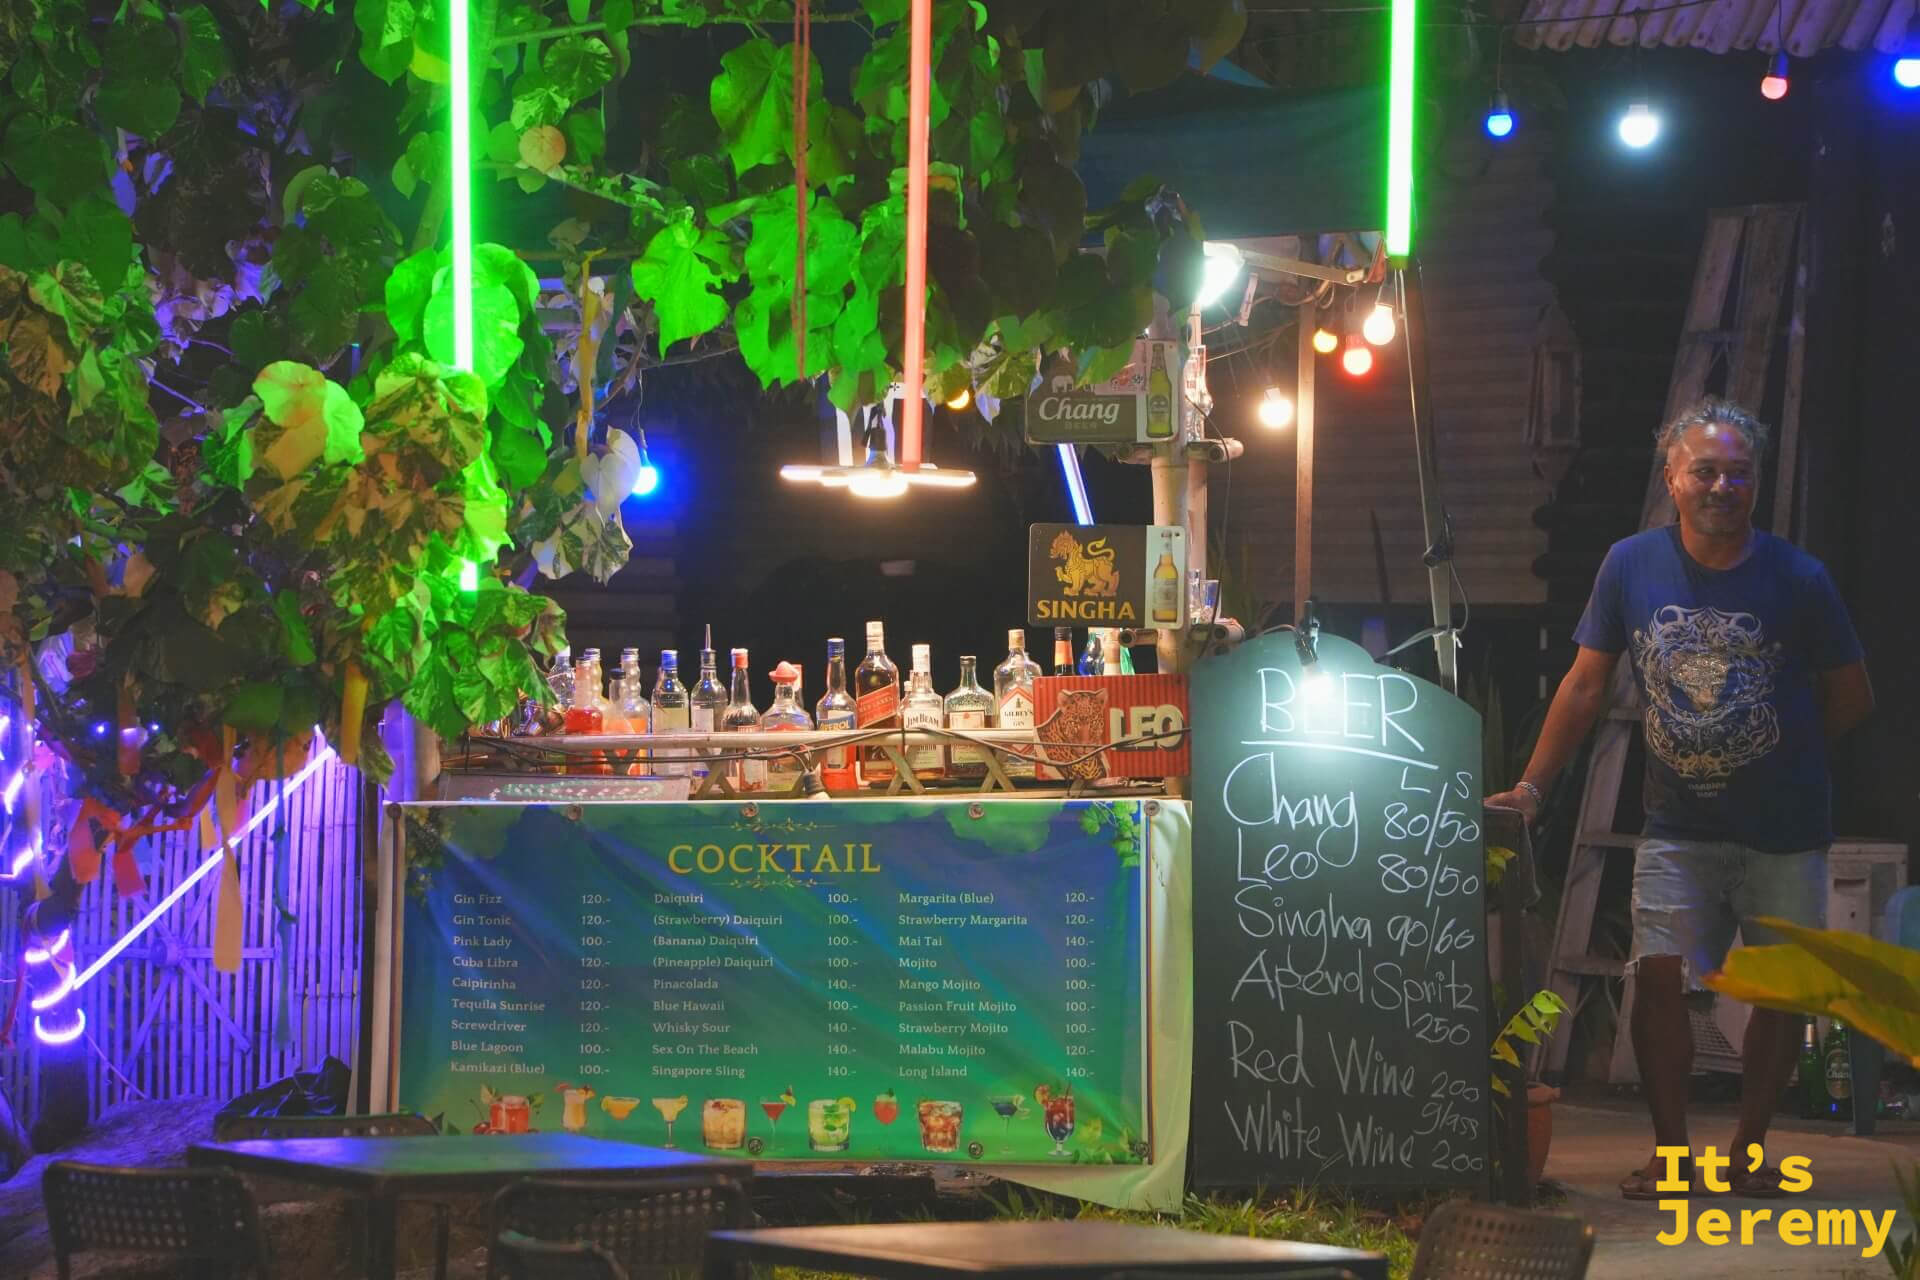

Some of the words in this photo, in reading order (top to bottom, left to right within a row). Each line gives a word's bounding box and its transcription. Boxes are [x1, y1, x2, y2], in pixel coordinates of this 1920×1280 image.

[1039, 397, 1120, 424] Chang
[1037, 600, 1136, 620] SINGHA
[1109, 704, 1184, 751] LEO
[1223, 752, 1359, 867] Chang
[1384, 782, 1480, 855] 80/50
[668, 843, 881, 874] COCKTAIL
[1238, 827, 1318, 883] Leo
[1377, 853, 1479, 908] 80/50
[454, 894, 475, 904] Gin
[479, 894, 502, 904] Fizz
[582, 894, 611, 904] 120.-
[654, 894, 704, 905] Daiquiri
[827, 893, 858, 904] 100.-
[899, 893, 957, 905] Margarita
[959, 893, 994, 904] (Blue)
[1065, 893, 1095, 903] 120.-
[453, 915, 474, 925] Gin
[478, 916, 513, 926] Tonic
[581, 915, 611, 925] 120.-
[653, 914, 730, 928] (Strawberry)
[733, 914, 783, 928] Daiquiri
[827, 914, 858, 925] 100.-
[898, 914, 967, 927] Strawberry
[970, 914, 1028, 927] Margarita
[1065, 915, 1095, 925] 120.-
[1234, 883, 1372, 972] Singha
[453, 936, 480, 946] Pink
[483, 936, 512, 949] Lady
[581, 936, 611, 946] 100.-
[653, 935, 706, 947] (Banana)
[709, 935, 759, 948] Daiquiri
[827, 936, 858, 946] 100.-
[898, 936, 921, 946] Mai
[924, 936, 943, 946] Tai
[1065, 936, 1095, 946] 140.-
[452, 956, 483, 968] Cuba
[487, 957, 519, 969] Libra
[581, 957, 611, 968] 120.-
[653, 956, 721, 970] (Pineapple)
[724, 956, 774, 970] Daiquiri
[827, 957, 859, 968] 100.-
[898, 957, 937, 970] Mojito
[1065, 958, 1096, 968] 100.-
[452, 977, 516, 991] Caipirinha
[581, 979, 610, 990] 120.-
[653, 978, 719, 990] Pinacolada
[827, 979, 857, 990] 140.-
[899, 979, 940, 992] Mango
[942, 979, 981, 992] Mojito
[1065, 980, 1096, 990] 100.-
[1371, 959, 1480, 1029] Spritz
[452, 998, 497, 1012] Tequila
[499, 1000, 545, 1012] Sunrise
[580, 1001, 610, 1011] 120.-
[653, 1000, 680, 1012] Blue
[683, 1000, 725, 1012] Hawaii
[827, 1000, 858, 1011] 100.-
[899, 1001, 943, 1012] Passion
[946, 1001, 975, 1012] Fruit
[978, 1001, 1017, 1014] Mojito
[1065, 1002, 1096, 1012] 100.-
[451, 1019, 527, 1032] Screwdriver
[580, 1022, 609, 1033] 120.-
[653, 1023, 700, 1036] Whisky
[702, 1023, 731, 1033] Sour
[827, 1023, 857, 1033] 140.-
[898, 1022, 967, 1036] Strawberry
[970, 1022, 1009, 1036] Mojito
[1065, 1023, 1096, 1034] 100.-
[1412, 1013, 1471, 1045] 250
[451, 1040, 478, 1052] Blue
[480, 1041, 524, 1055] Lagoon
[579, 1043, 610, 1054] 100.-
[652, 1044, 673, 1055] Sex
[676, 1044, 694, 1055] On
[698, 1044, 720, 1055] The
[723, 1043, 758, 1055] Beach
[827, 1044, 857, 1055] 140.-
[899, 1044, 944, 1055] Malabu
[947, 1045, 986, 1059] Mojito
[1065, 1046, 1095, 1056] 120.-
[1227, 1014, 1315, 1088] Red
[1328, 1031, 1415, 1098] Wine
[1431, 1071, 1480, 1102] 200
[450, 1062, 507, 1074] Kamikazi
[510, 1062, 545, 1075] (Blue)
[579, 1065, 610, 1075] 100.-
[651, 1065, 712, 1078] Singapore
[715, 1065, 745, 1079] Sling
[827, 1066, 857, 1076] 140.-
[899, 1065, 928, 1080] Long
[930, 1065, 968, 1077] Island
[1065, 1067, 1095, 1077] 140.-
[1413, 1101, 1479, 1140] glass
[1224, 1090, 1329, 1160] White
[1338, 1112, 1414, 1169] Wine
[1432, 1140, 1484, 1172] 200
